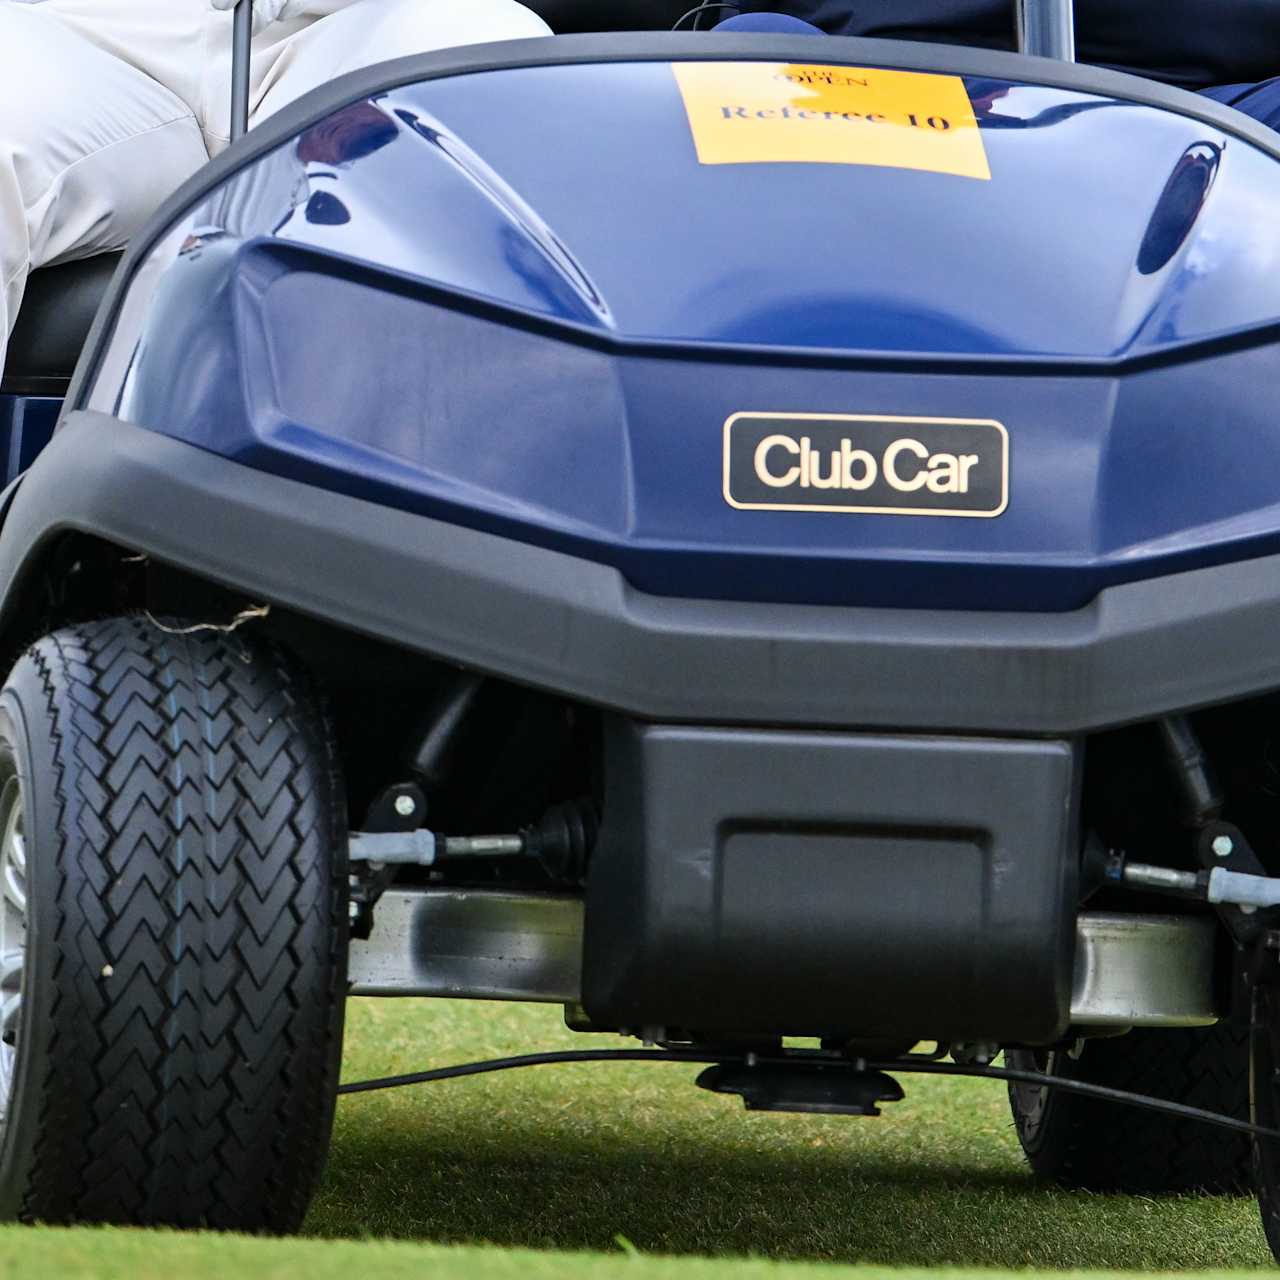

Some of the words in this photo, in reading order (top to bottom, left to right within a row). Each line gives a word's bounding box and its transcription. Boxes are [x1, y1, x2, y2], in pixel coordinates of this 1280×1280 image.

[721, 104, 887, 123] Referee
[907, 113, 951, 131] 10
[753, 434, 878, 492] Club
[882, 438, 979, 494] Car
